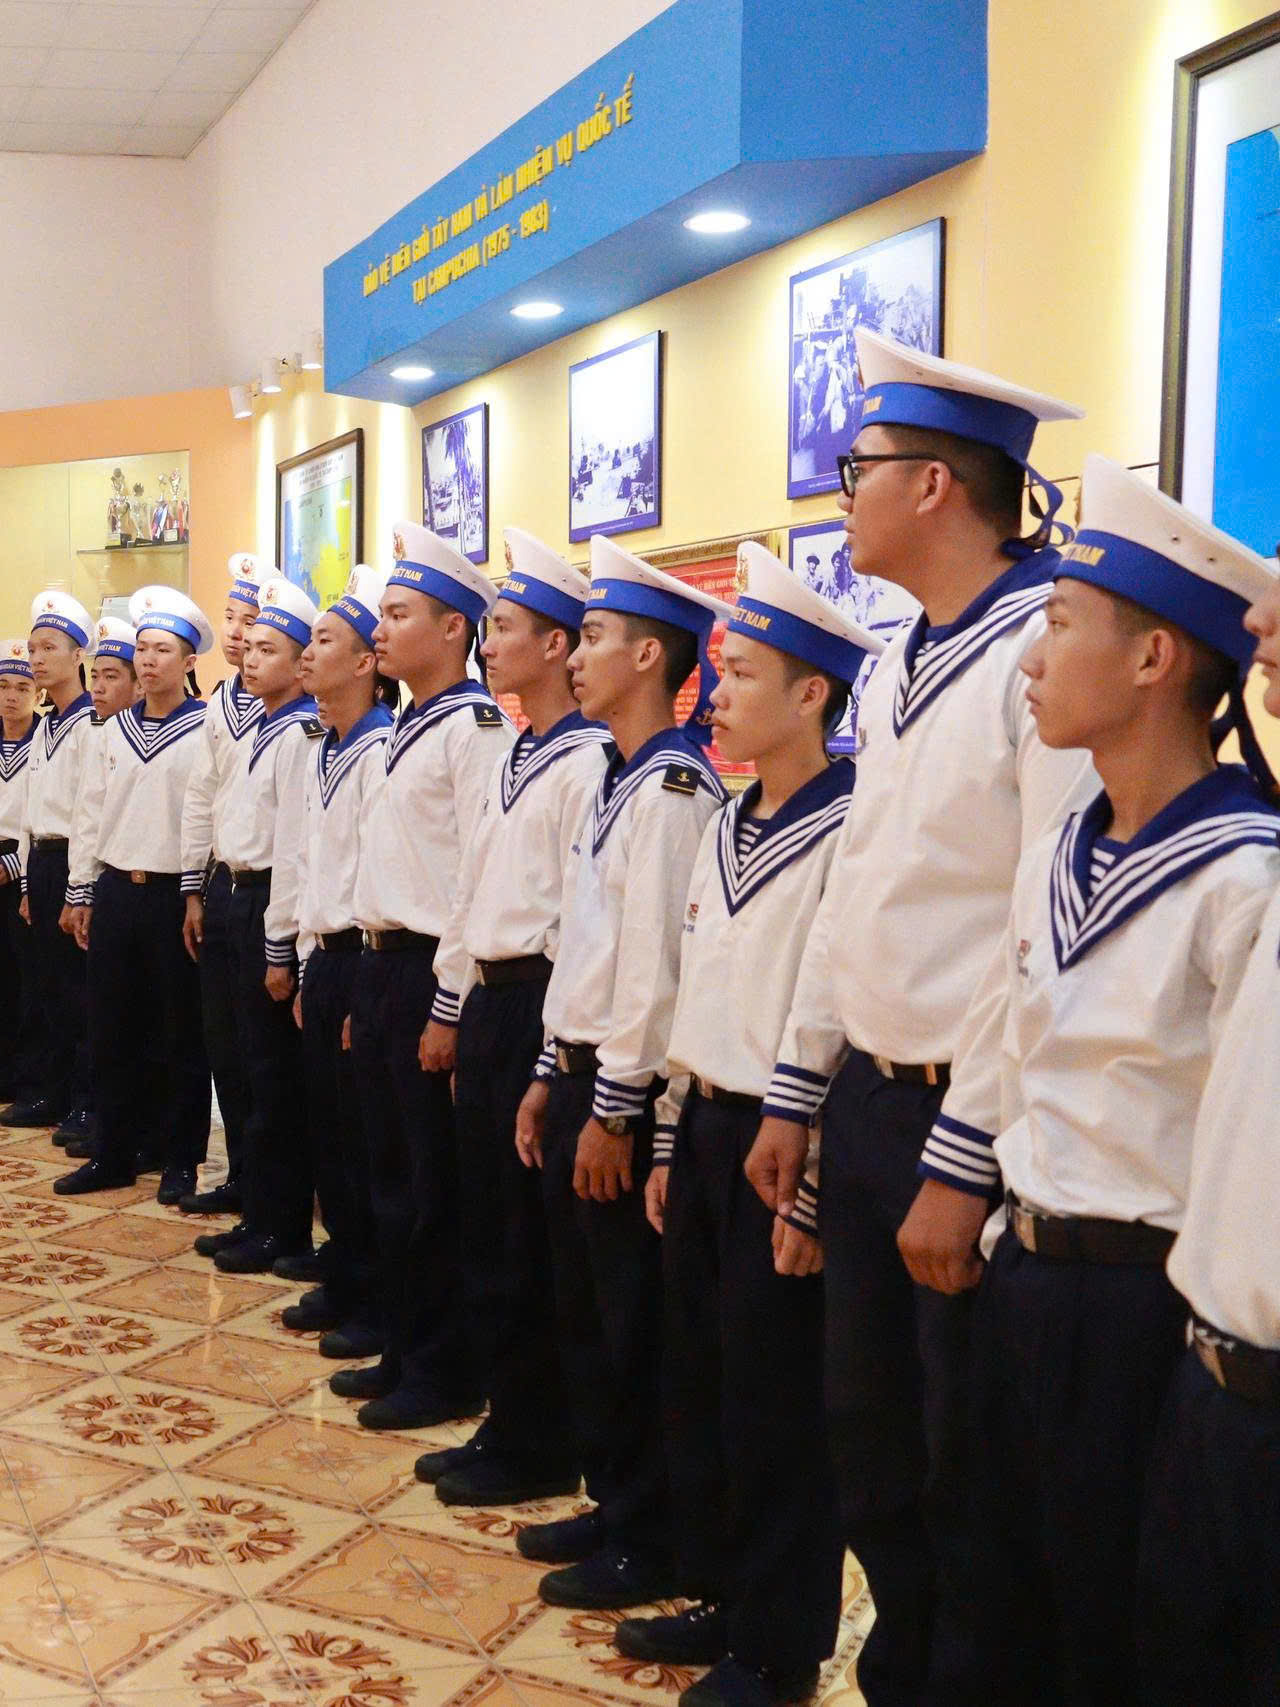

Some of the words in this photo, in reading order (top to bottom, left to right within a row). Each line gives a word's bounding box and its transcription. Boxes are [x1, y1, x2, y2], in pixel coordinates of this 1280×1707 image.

[363, 263, 379, 298] BẢO
[379, 253, 391, 286] VỆ
[392, 241, 412, 278] BIÊN
[412, 223, 431, 263] GIỚI
[432, 215, 449, 251] TÂY
[451, 202, 474, 238] NAM
[474, 183, 489, 223] VÀ
[490, 172, 515, 212] LÀM
[516, 144, 554, 194] NHIỆM
[555, 130, 574, 168] VỤ
[576, 91, 613, 153] QUỐC
[614, 72, 635, 129] TẾ
[412, 274, 428, 307] TẠI
[428, 242, 481, 297] CAMPUCHIA
[482, 223, 511, 268] (1975
[404, 569, 423, 582] NAM
[508, 580, 527, 594] NAM
[344, 604, 361, 619] NAM
[273, 613, 290, 627] NAM
[743, 611, 771, 631] NAM
